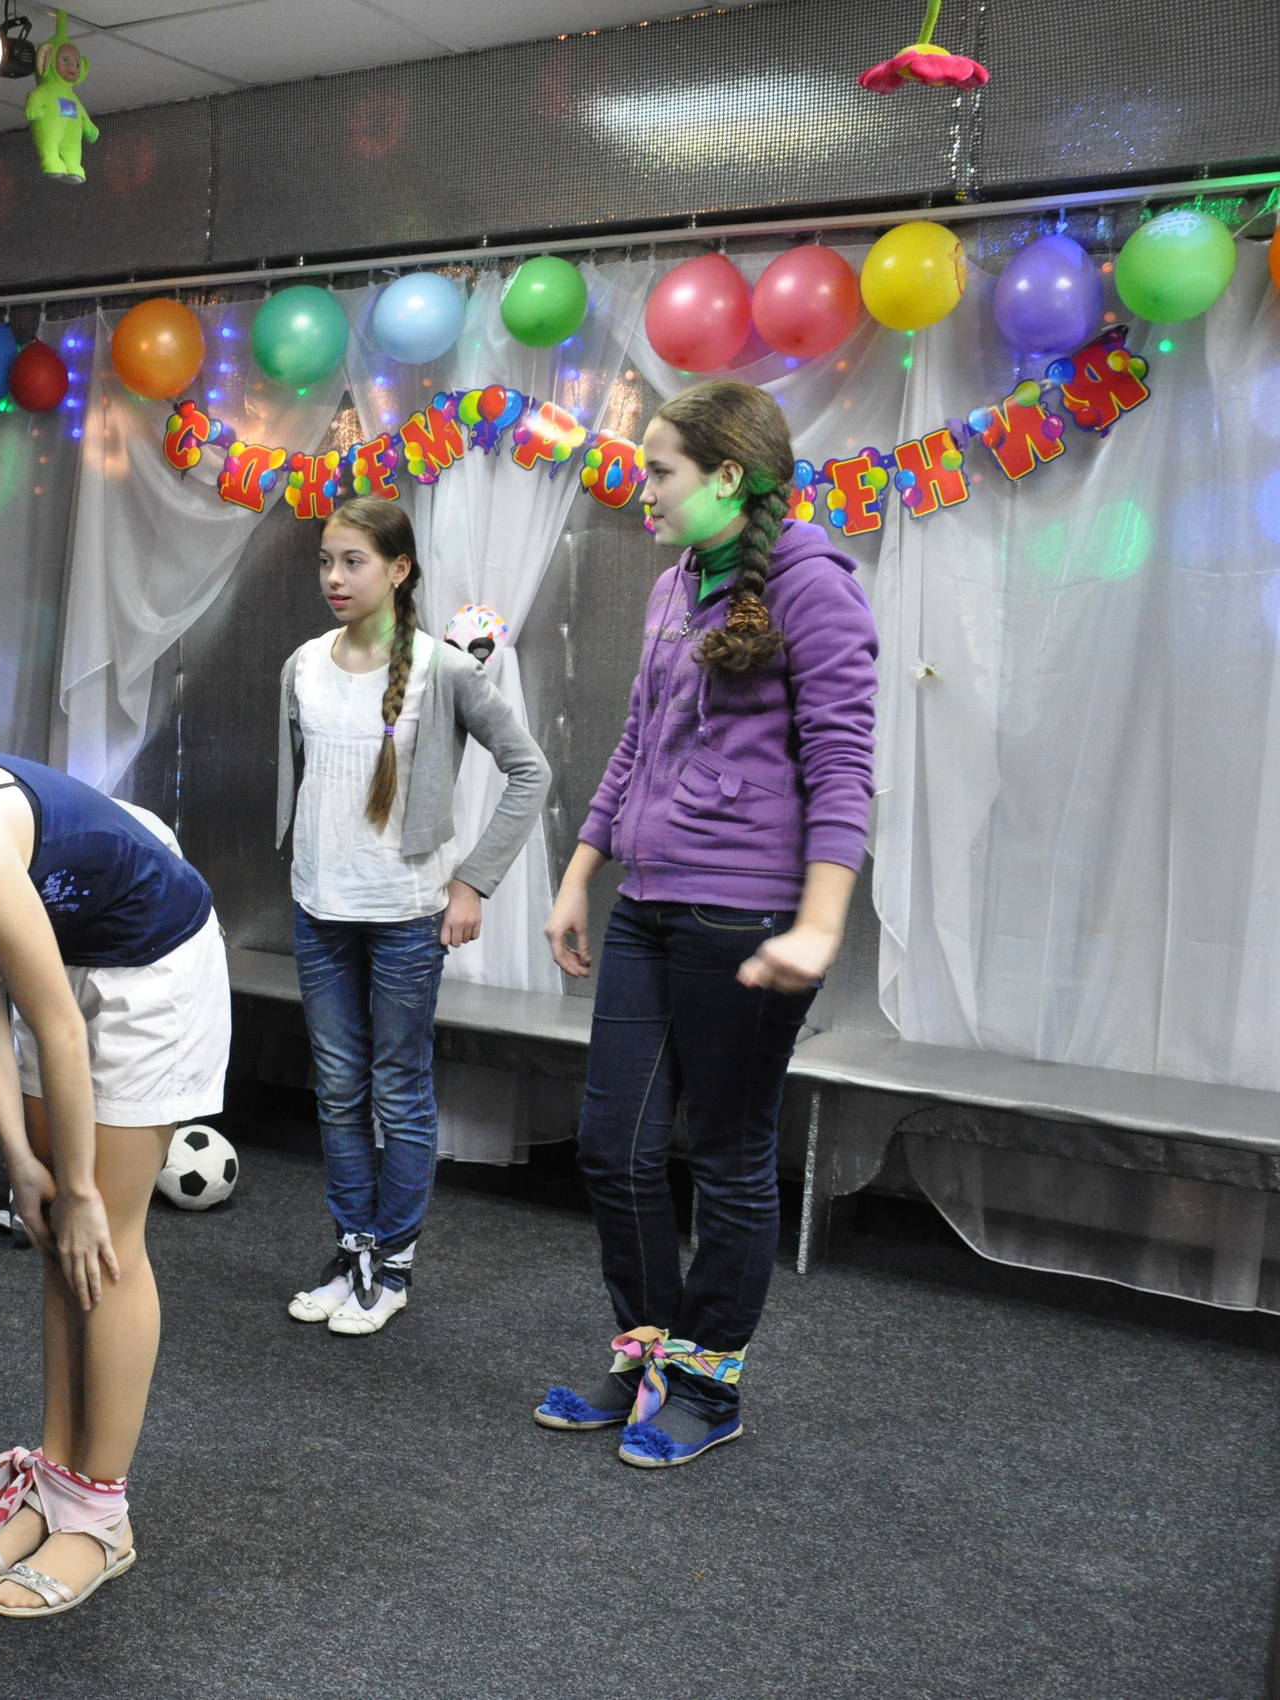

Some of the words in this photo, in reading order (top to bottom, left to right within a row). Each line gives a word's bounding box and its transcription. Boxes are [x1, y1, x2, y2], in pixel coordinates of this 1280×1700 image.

[163, 403, 216, 472] С
[217, 403, 466, 519] ДНЕМ
[512, 332, 1150, 537] РОЕНИЯ
